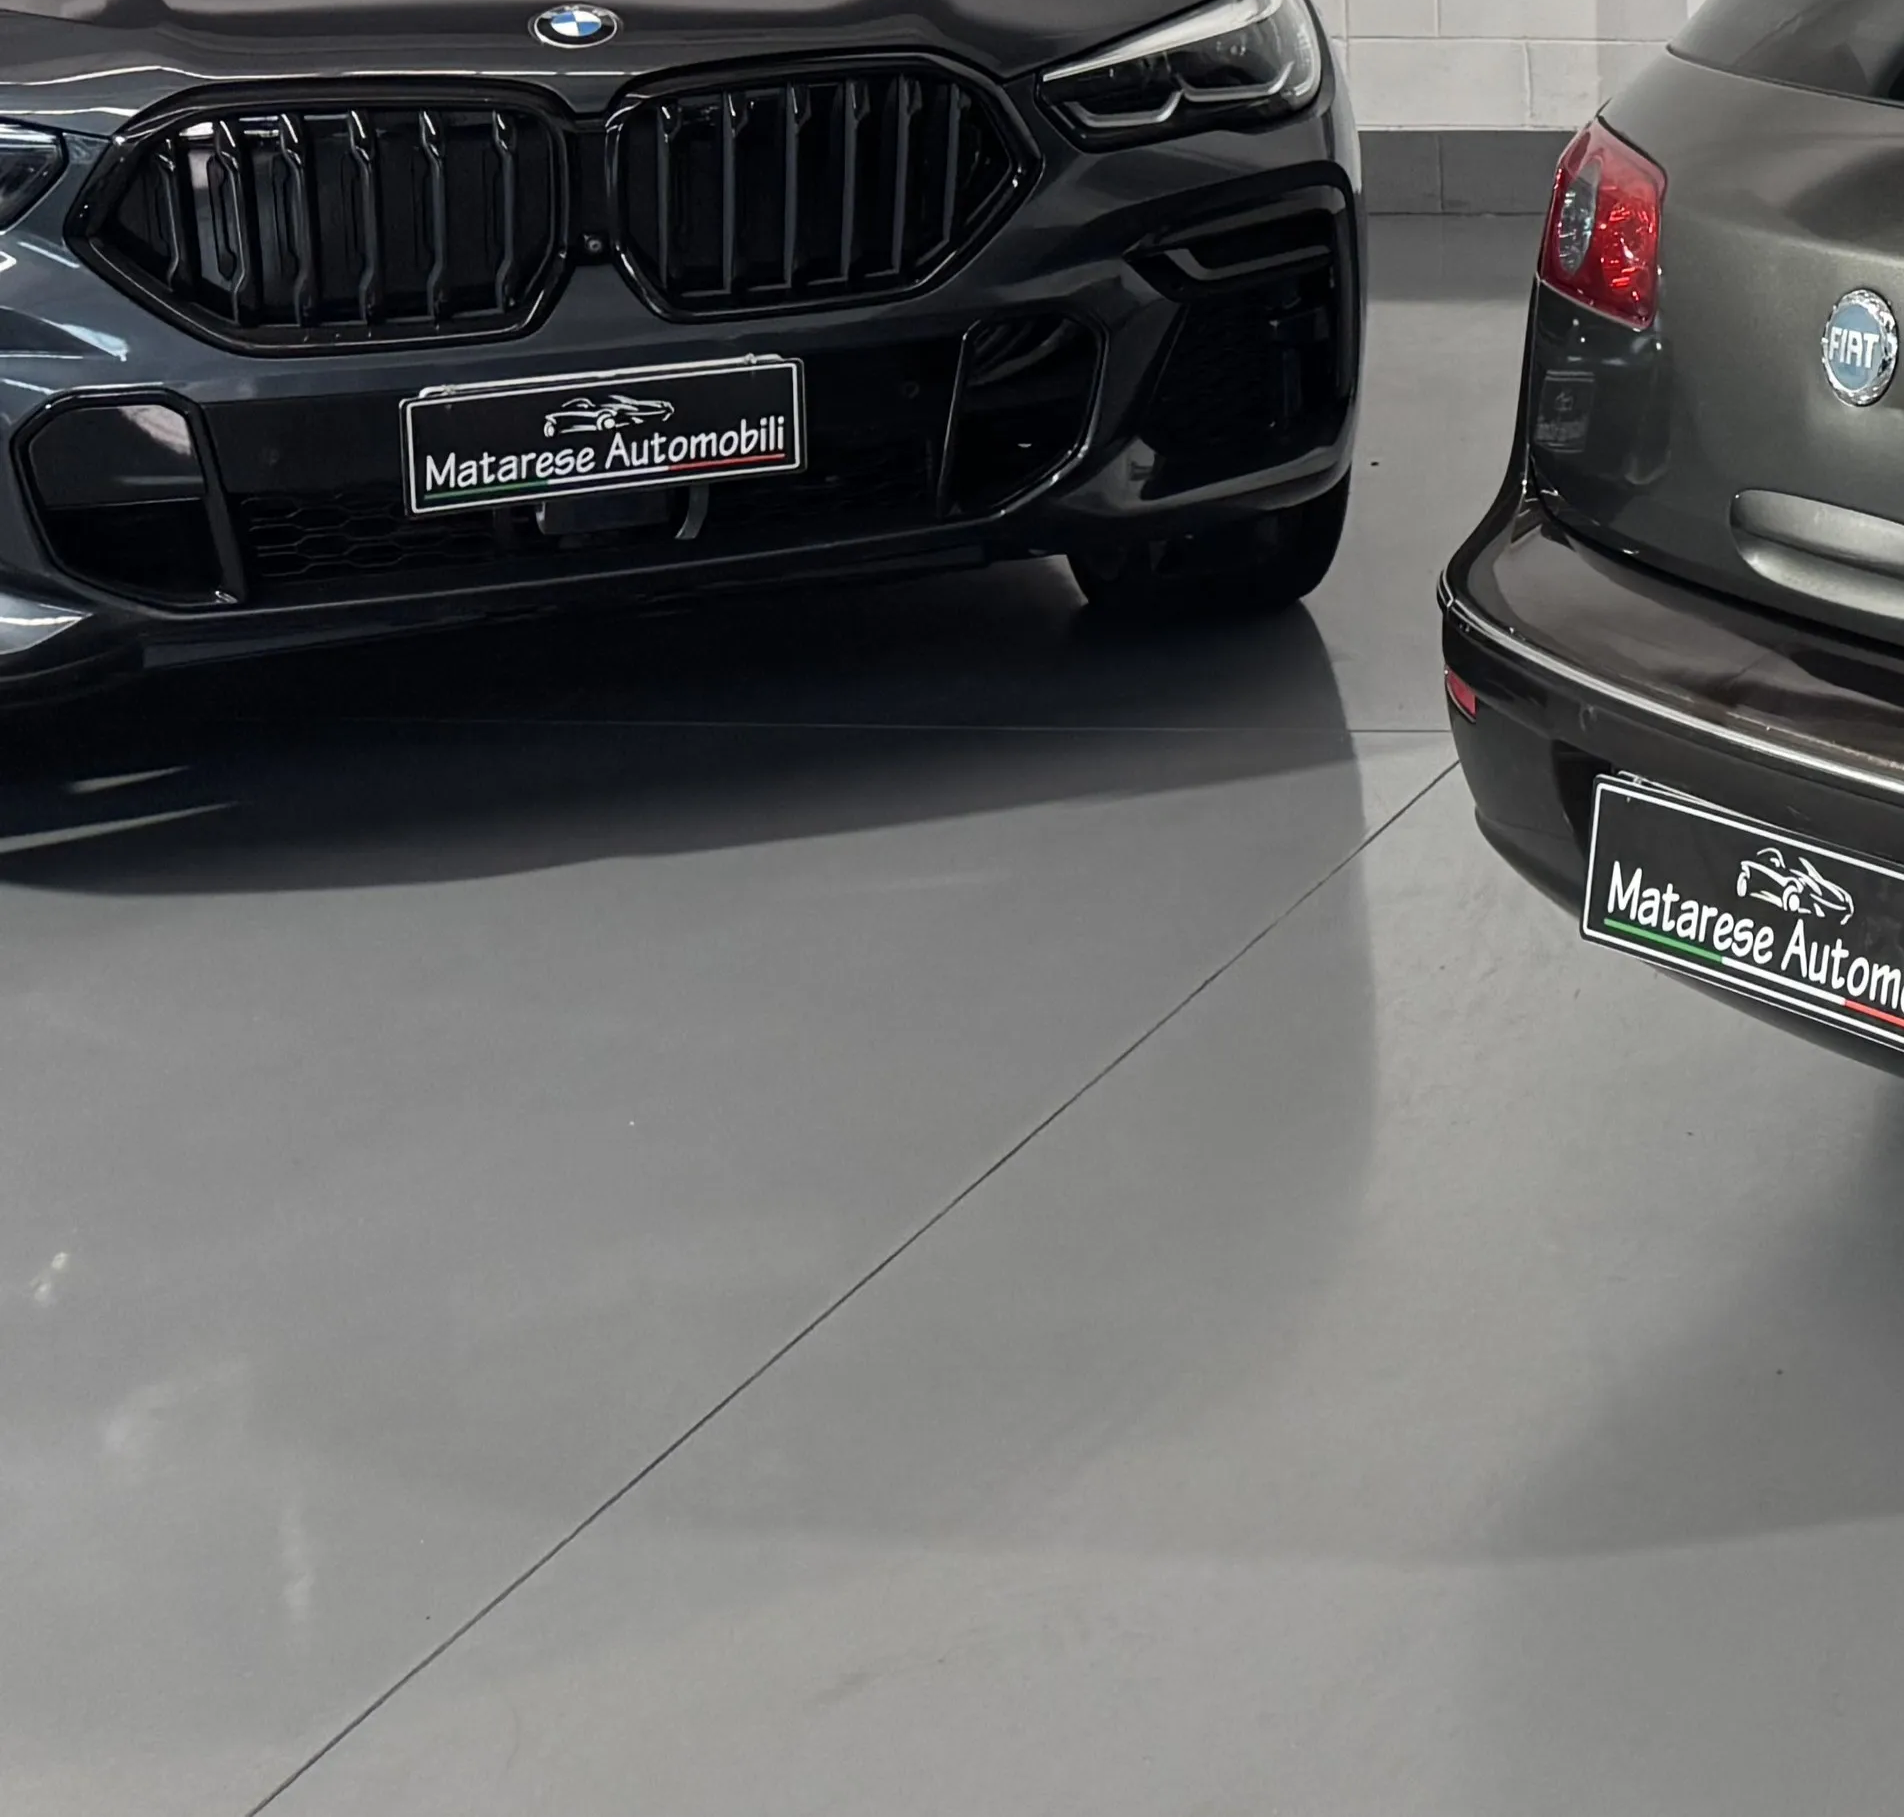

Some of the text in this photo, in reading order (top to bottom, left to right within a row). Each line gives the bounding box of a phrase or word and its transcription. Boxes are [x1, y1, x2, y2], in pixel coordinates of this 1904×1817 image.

[1829, 326, 1879, 368] FIAT
[425, 416, 785, 491] Matarese Automobili
[1607, 860, 1774, 964] Matarese
